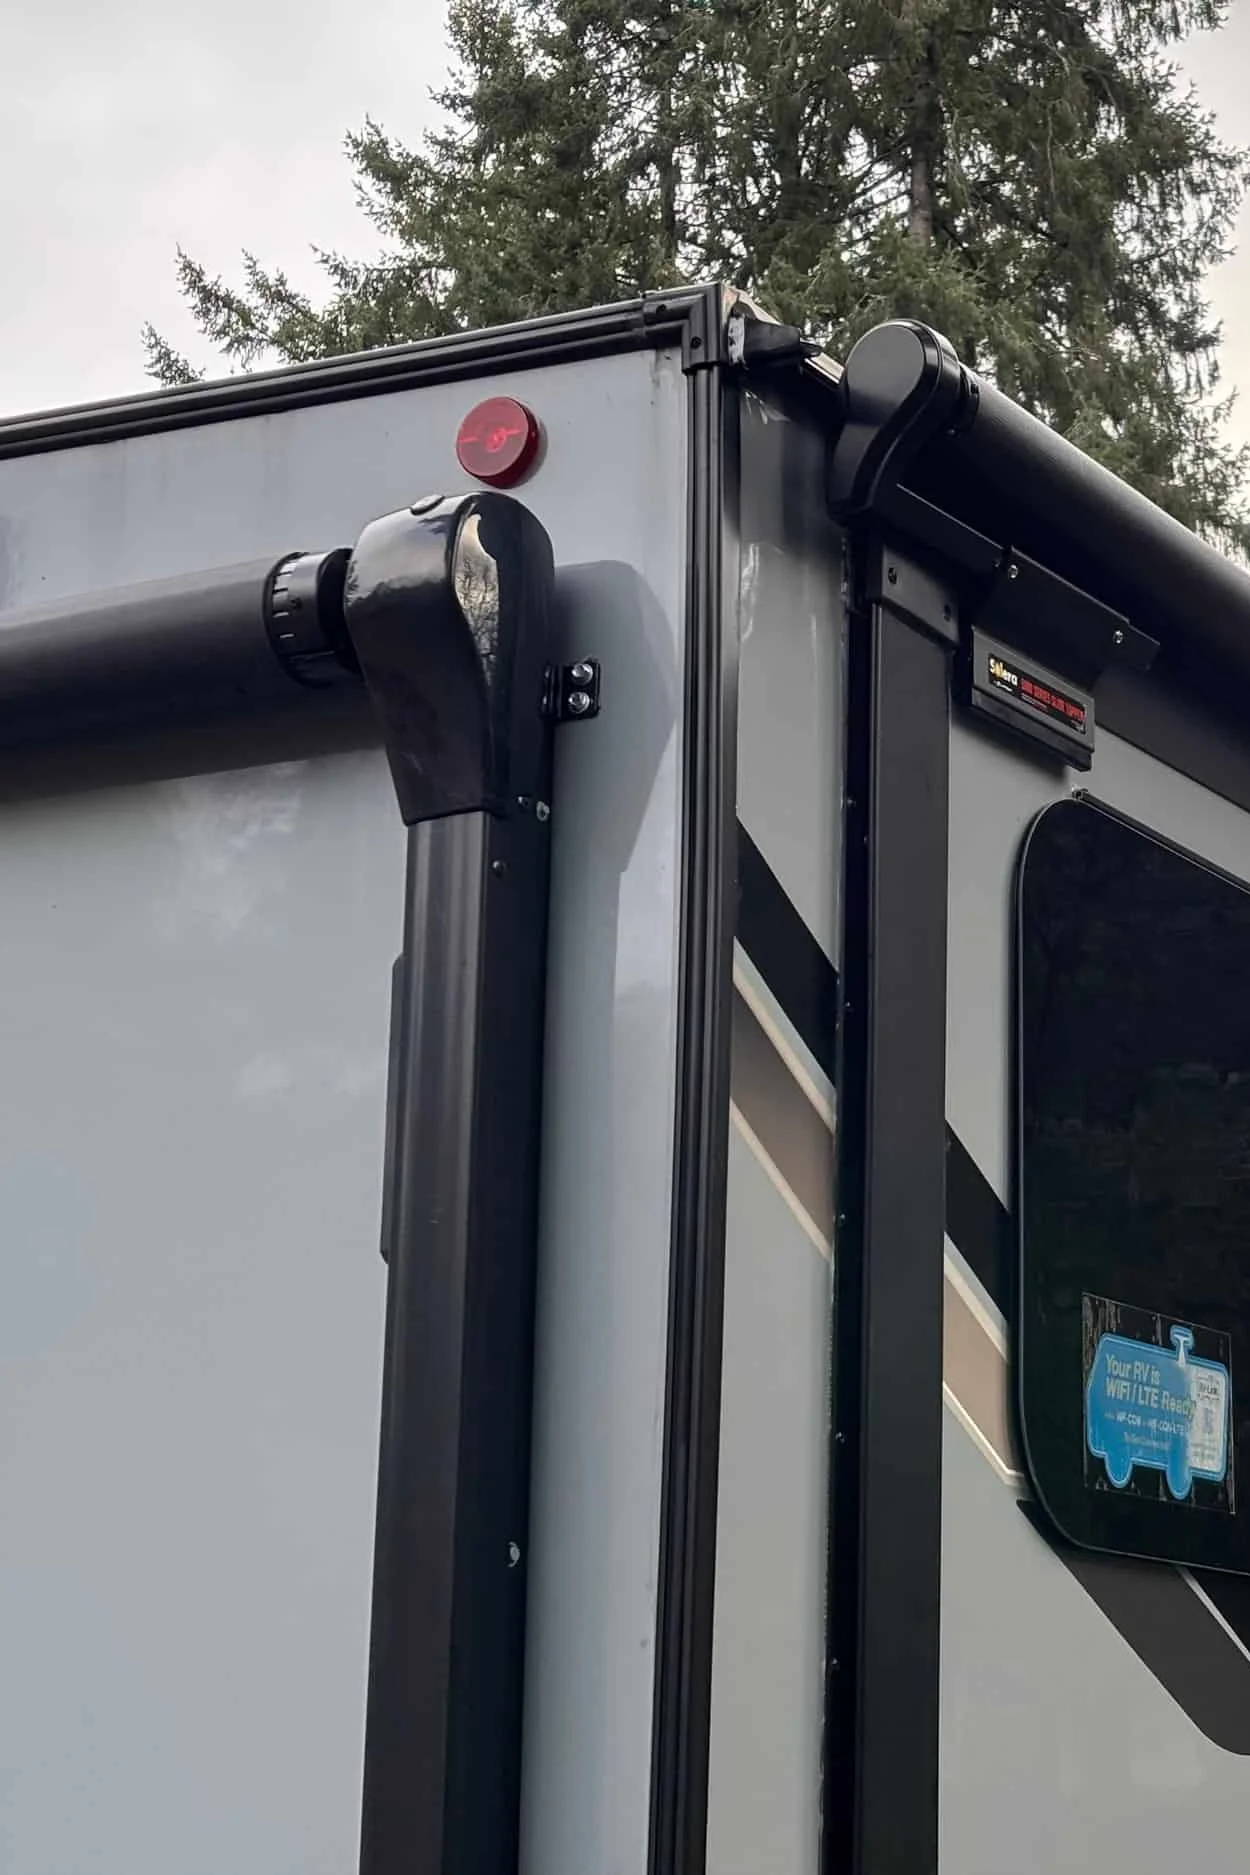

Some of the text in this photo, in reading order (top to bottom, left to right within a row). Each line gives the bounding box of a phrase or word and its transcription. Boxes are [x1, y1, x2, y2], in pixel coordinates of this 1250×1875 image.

[990, 658, 1018, 686] Solera
[1106, 1353, 1160, 1385] Your RV is
[1137, 1384, 1159, 1408] LTE
[1161, 1390, 1197, 1421] Ready
